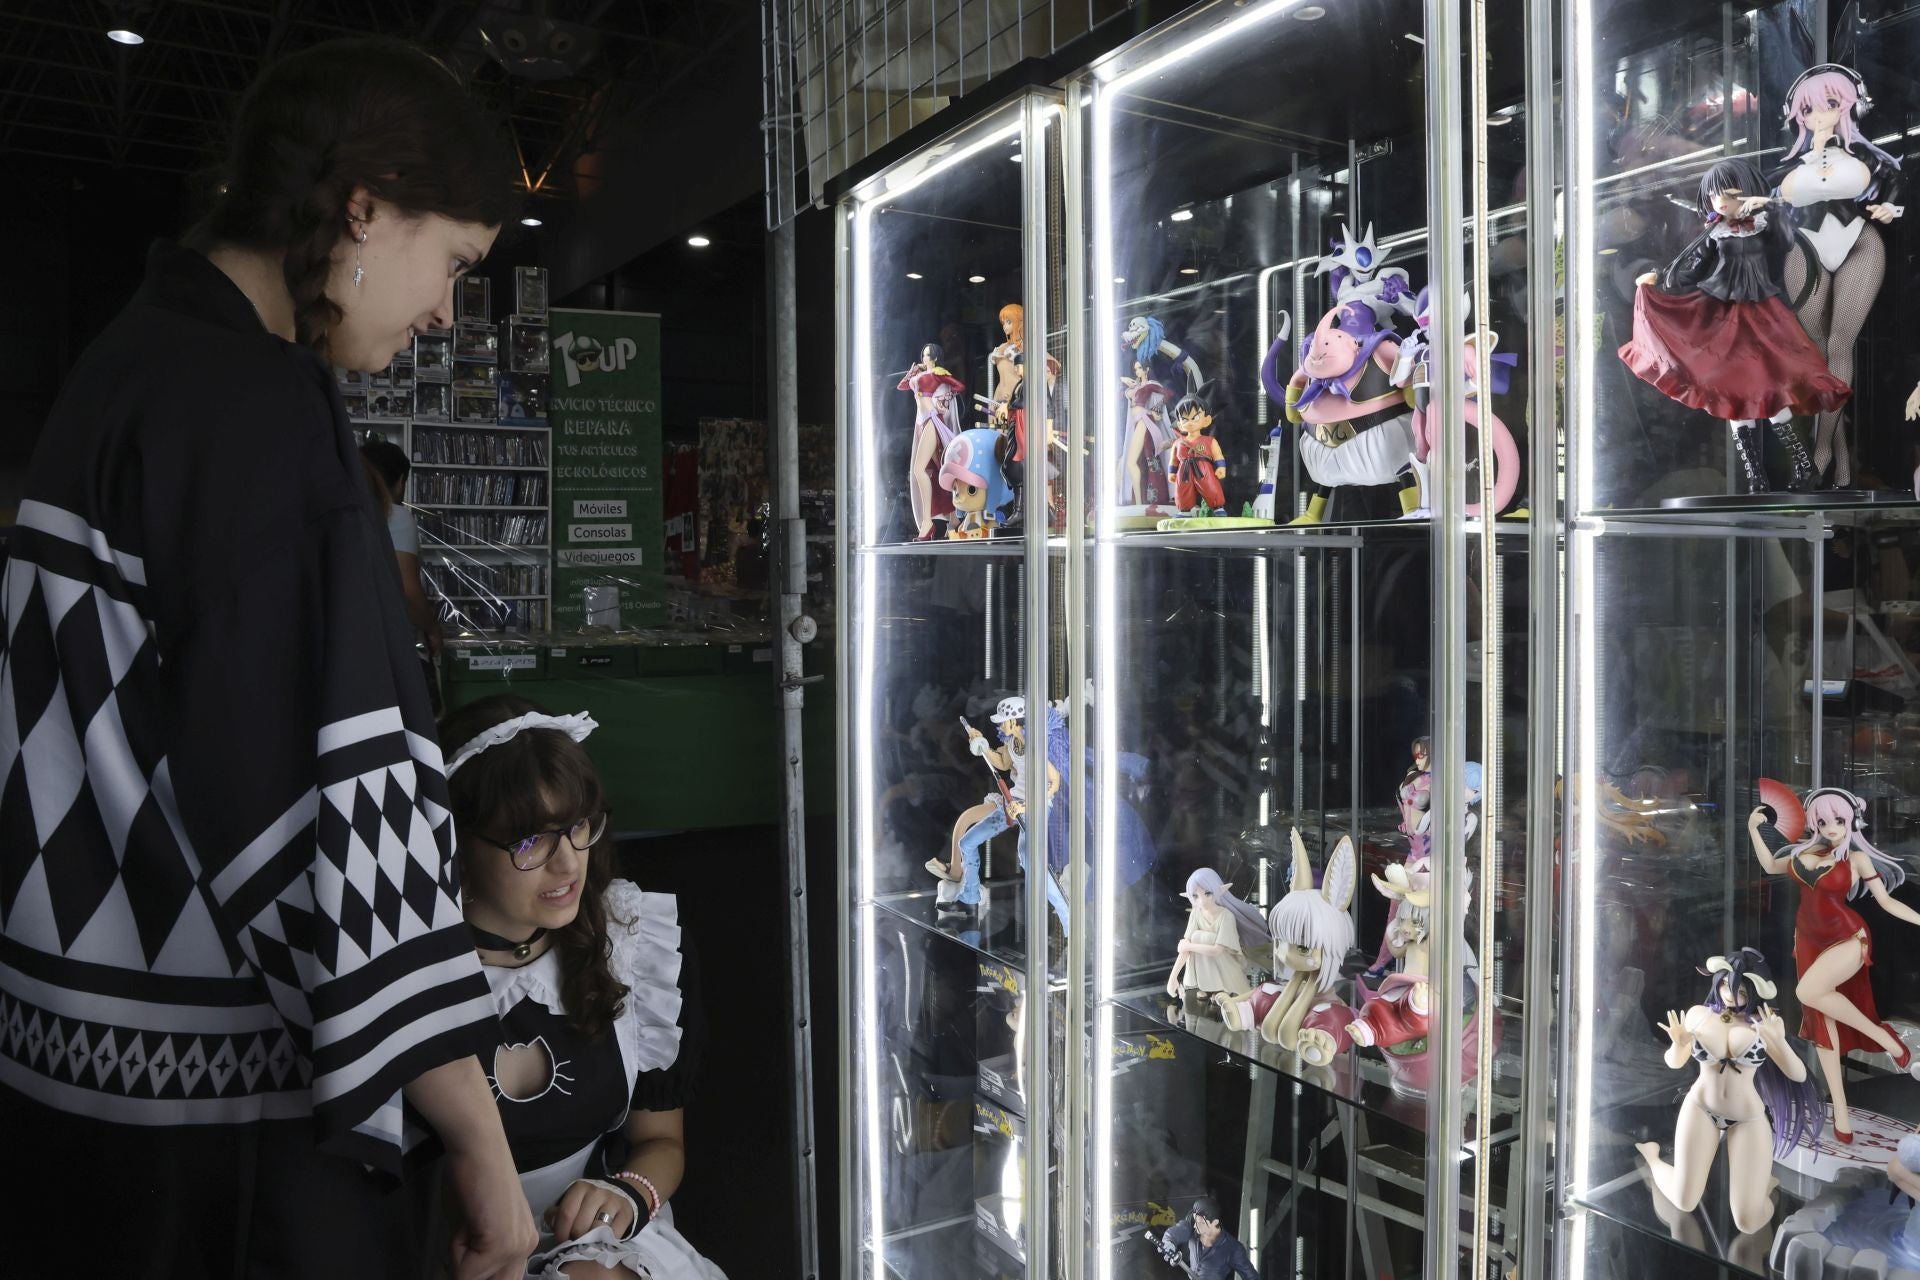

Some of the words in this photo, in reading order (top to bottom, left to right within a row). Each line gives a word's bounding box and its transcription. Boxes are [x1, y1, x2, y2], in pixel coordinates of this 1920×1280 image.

[551, 398, 594, 411] RVICIO
[598, 393, 655, 413] TÉCNICO
[564, 419, 632, 435] REPARA
[557, 445, 578, 456] TUS
[580, 441, 638, 456] ARTÍCULOS
[556, 462, 648, 478] ECNOLÓGICOS
[579, 504, 623, 515] Móviles
[573, 527, 627, 538] Consolas
[564, 552, 636, 565] Videojuegos
